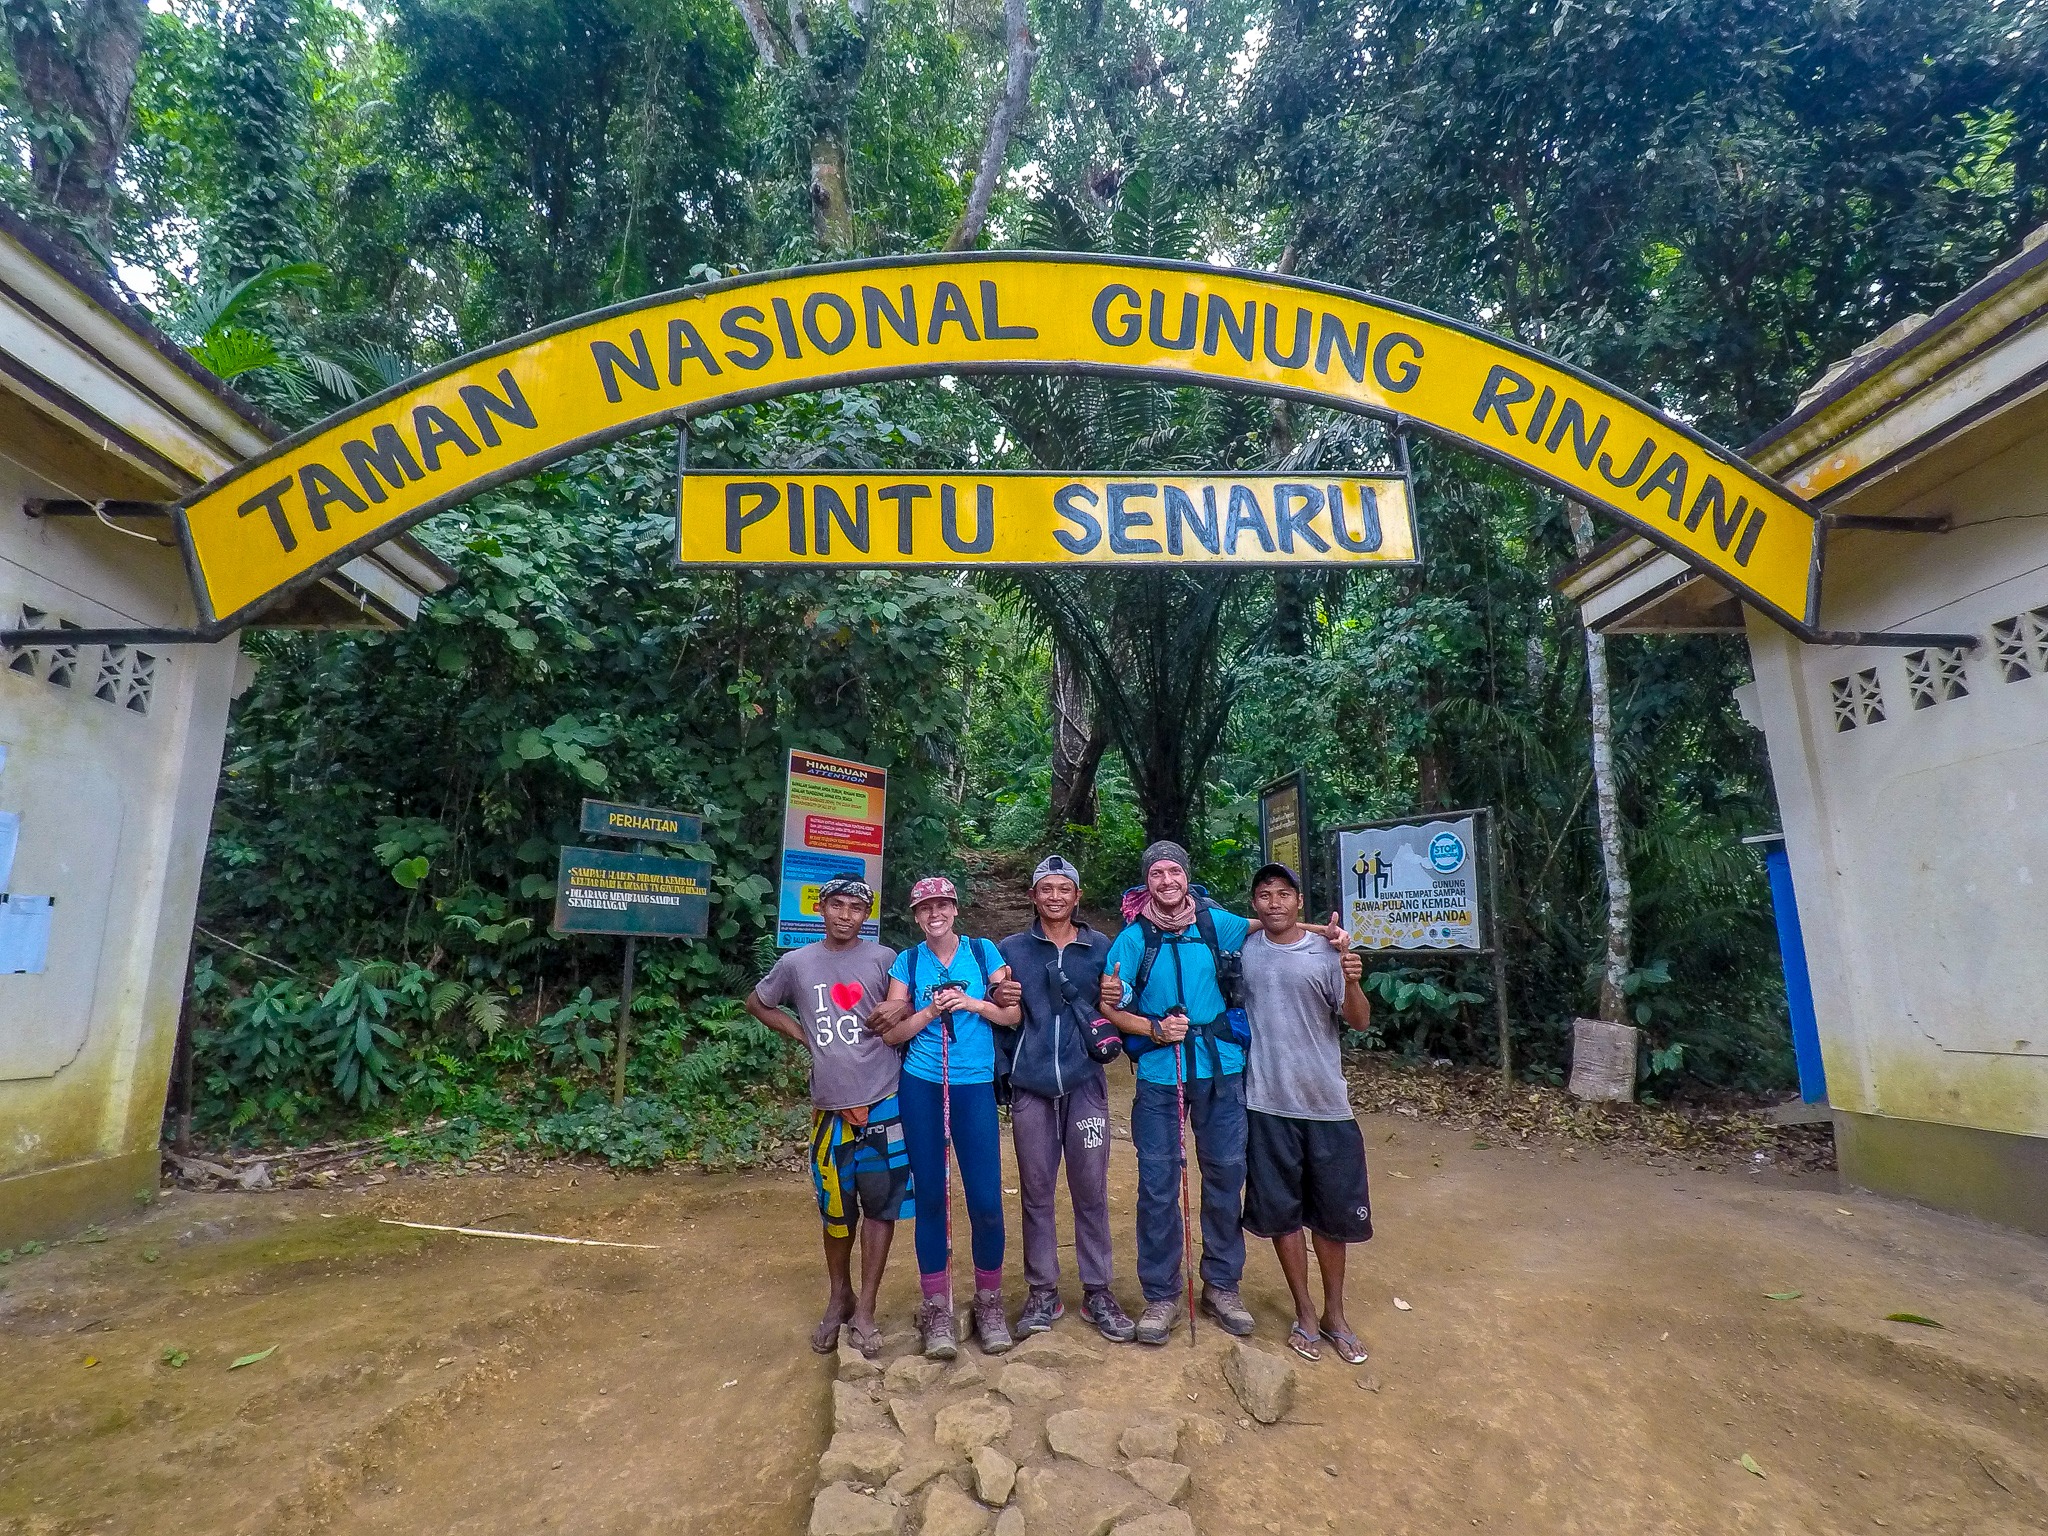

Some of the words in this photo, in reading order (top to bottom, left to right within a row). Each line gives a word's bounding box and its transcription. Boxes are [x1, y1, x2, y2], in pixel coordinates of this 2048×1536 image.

[237, 368, 538, 552] TAMAN
[590, 280, 1039, 403] NASIONAL
[1092, 283, 1425, 393] GUNUNG
[1472, 364, 1768, 568] RINJANI
[725, 481, 995, 555] PINTU
[1052, 482, 1384, 556] SENARU
[805, 760, 868, 779] HIMBAUAN
[807, 768, 866, 784] ATTENTION
[609, 812, 678, 833] PERHATIAN
[1434, 844, 1457, 854] STOP
[571, 867, 607, 879] SAMPAH
[608, 870, 636, 881] HARUS
[1432, 879, 1466, 889] GUNUNG
[570, 888, 609, 900] DILARANG
[609, 891, 650, 903] MEMBUANG
[649, 895, 680, 906] SAMPAH
[1379, 891, 1404, 900] BUKAN
[1404, 889, 1432, 899] TEMPAT
[1433, 887, 1466, 898] SAMPAH
[567, 897, 628, 911] SEMBARANGAN
[1355, 901, 1380, 912] BAWA
[1382, 899, 1420, 911] PULANG
[1422, 897, 1467, 909] KEMBALI
[1388, 911, 1433, 923] SAMPAH
[1435, 909, 1467, 922] ANDA
[813, 983, 829, 1014] I
[815, 1014, 863, 1047] SG
[1075, 1116, 1106, 1131] BOSTON
